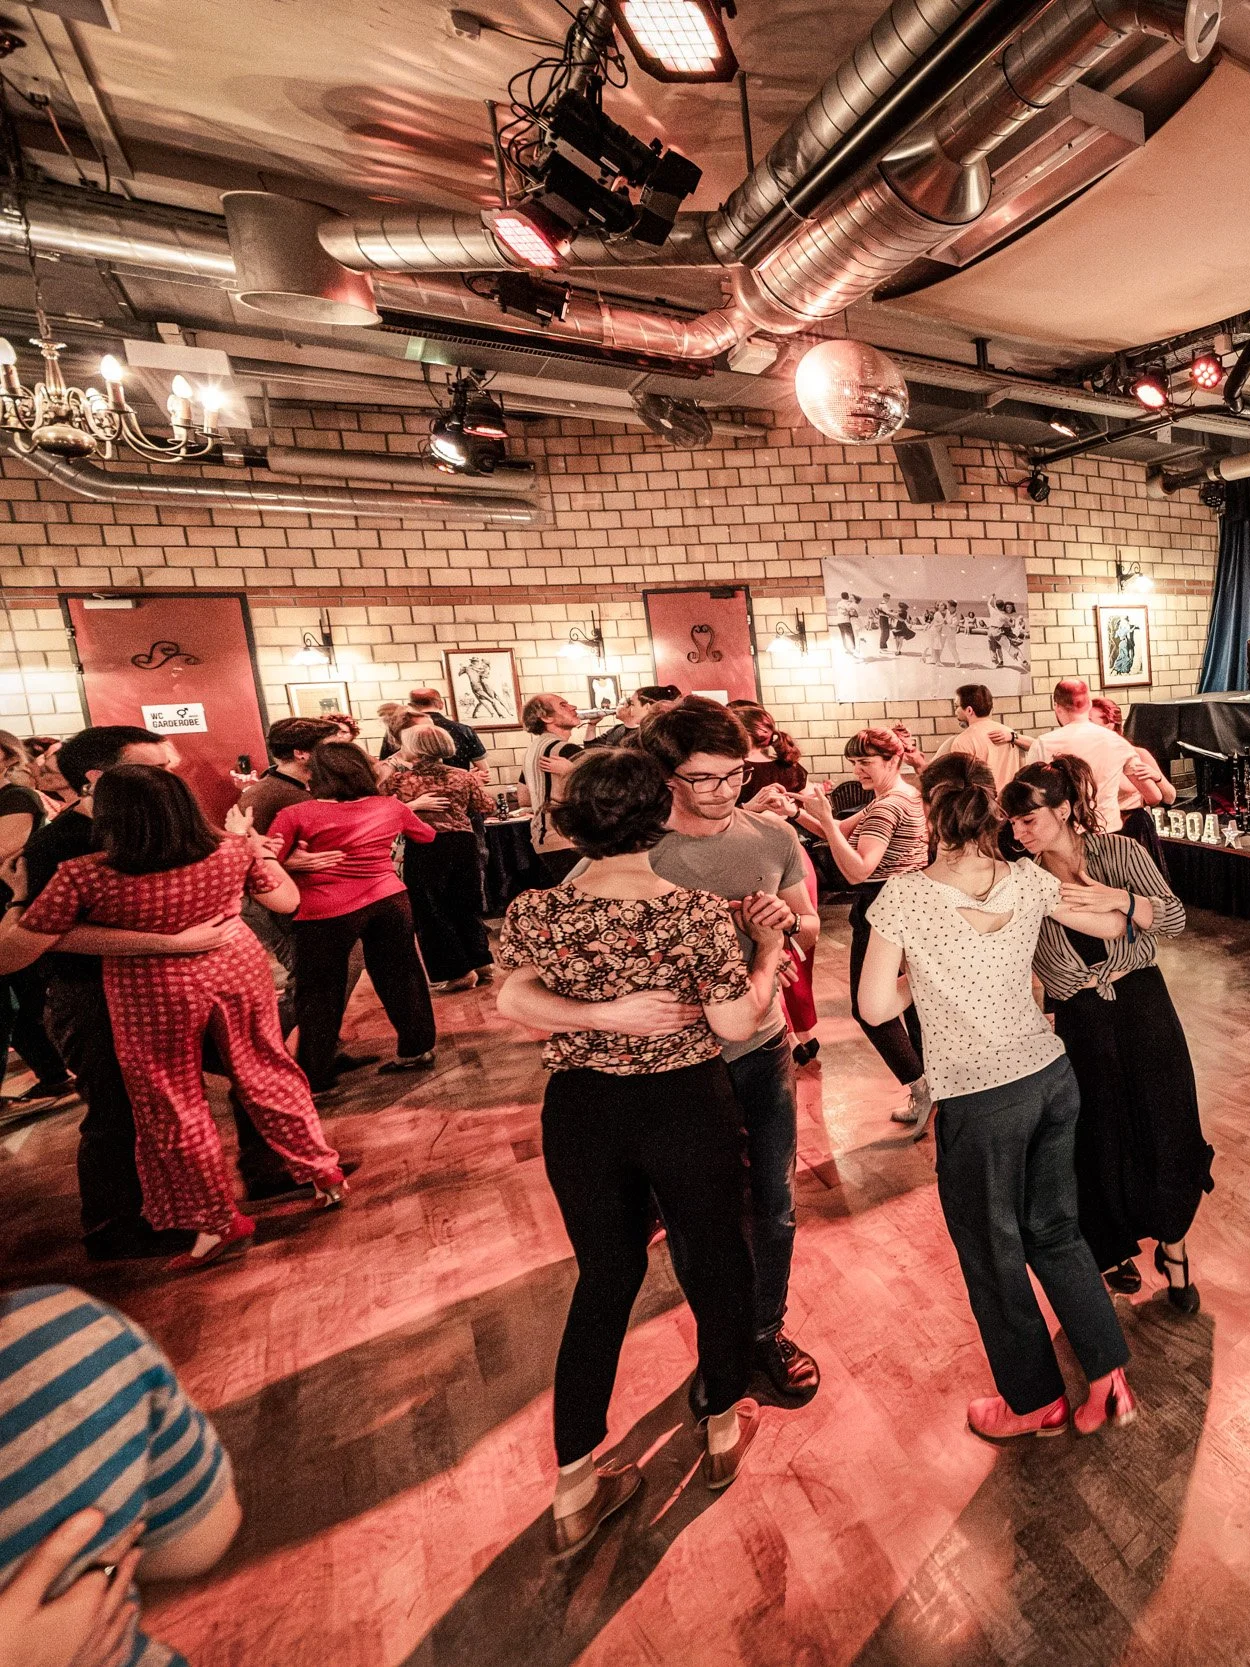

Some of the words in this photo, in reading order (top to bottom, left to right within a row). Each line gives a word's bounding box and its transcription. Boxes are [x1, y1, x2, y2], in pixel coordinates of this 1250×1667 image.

[150, 712, 164, 720] WC
[152, 718, 200, 728] GARDEROBE
[1144, 806, 1221, 845] LBOA
